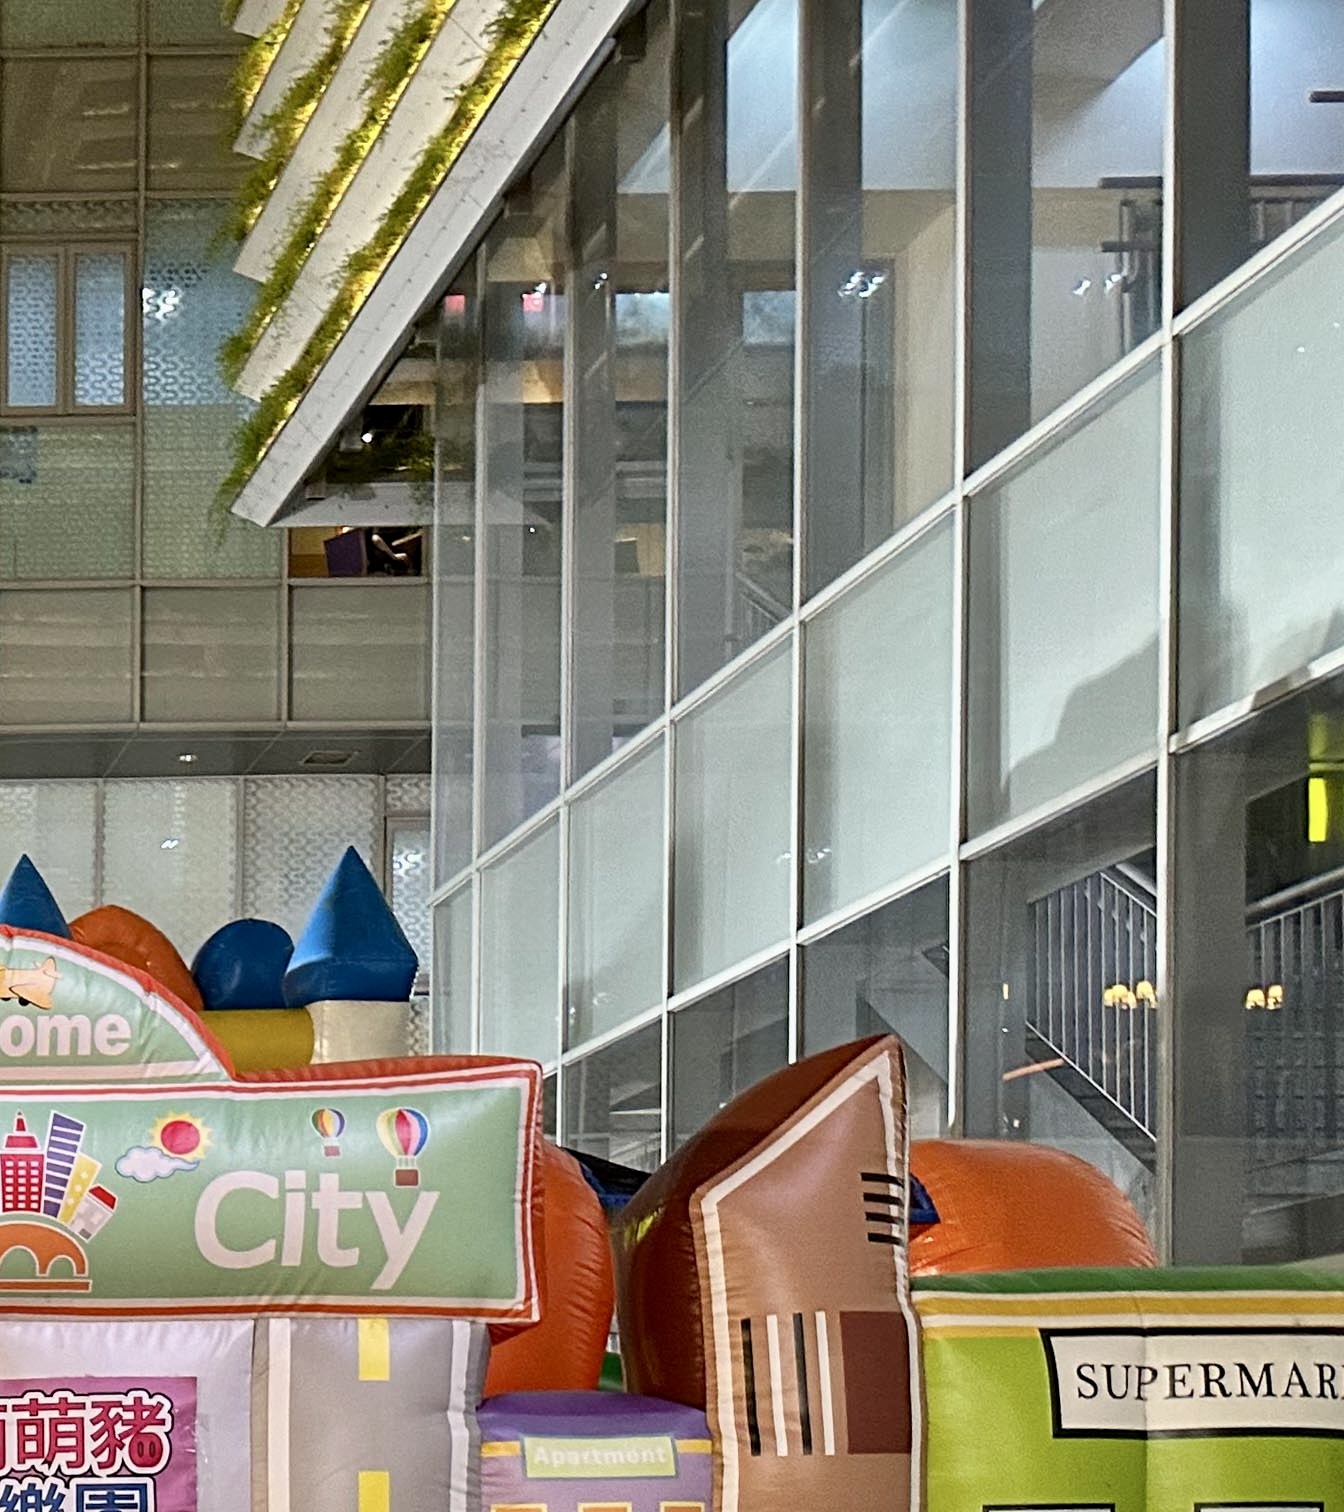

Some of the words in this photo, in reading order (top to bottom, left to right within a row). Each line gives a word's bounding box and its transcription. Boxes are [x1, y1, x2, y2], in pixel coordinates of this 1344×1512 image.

[193, 1172, 440, 1289] City
[1075, 1361, 1344, 1401] SUPERMAR
[533, 1446, 668, 1467] Apartment
